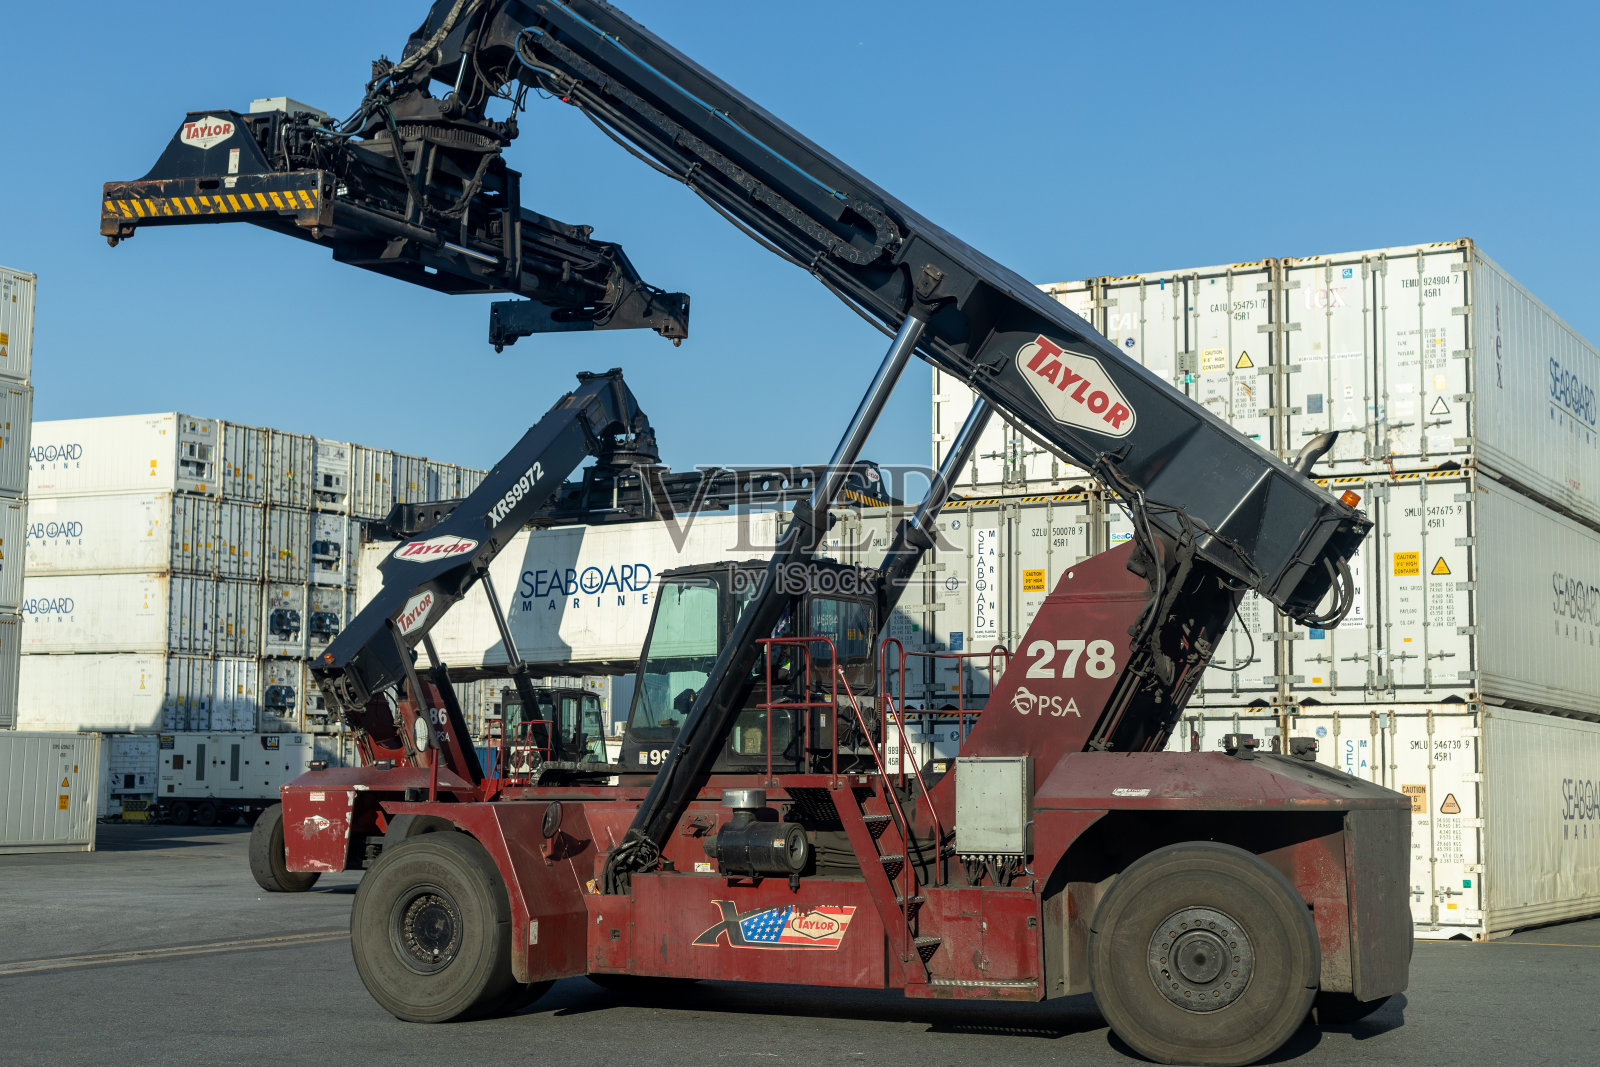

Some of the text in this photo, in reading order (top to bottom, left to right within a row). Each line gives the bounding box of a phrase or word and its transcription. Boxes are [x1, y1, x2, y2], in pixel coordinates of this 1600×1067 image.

[185, 123, 231, 139] TAYLOR
[1402, 275, 1458, 288] TEMU 924904 7
[1424, 288, 1441, 297] 45R1
[1210, 299, 1266, 313] CAIU 554751 7
[1233, 311, 1249, 320] 45R1
[1026, 336, 1129, 430] TAYLOR
[1549, 356, 1597, 425] SEABOARD
[488, 461, 545, 528] XRS9972
[1404, 505, 1462, 517] SMLU 547675 9
[1428, 518, 1444, 528] 45R1
[1031, 526, 1083, 537] SZLU 500078 9
[401, 542, 472, 557] TAYLOR
[520, 564, 652, 598] SEABOARD
[975, 530, 986, 628] SEABOARD
[522, 594, 649, 612] MARINE
[397, 593, 432, 633] TAYLOR
[1026, 639, 1116, 679] 278
[1038, 696, 1081, 718] PSA
[267, 737, 278, 746] CAT
[1410, 740, 1470, 750] SMLU 546730 9
[1434, 752, 1452, 761] 45R1
[1401, 785, 1426, 794] CAUTION
[796, 916, 834, 930] TAYLOR
